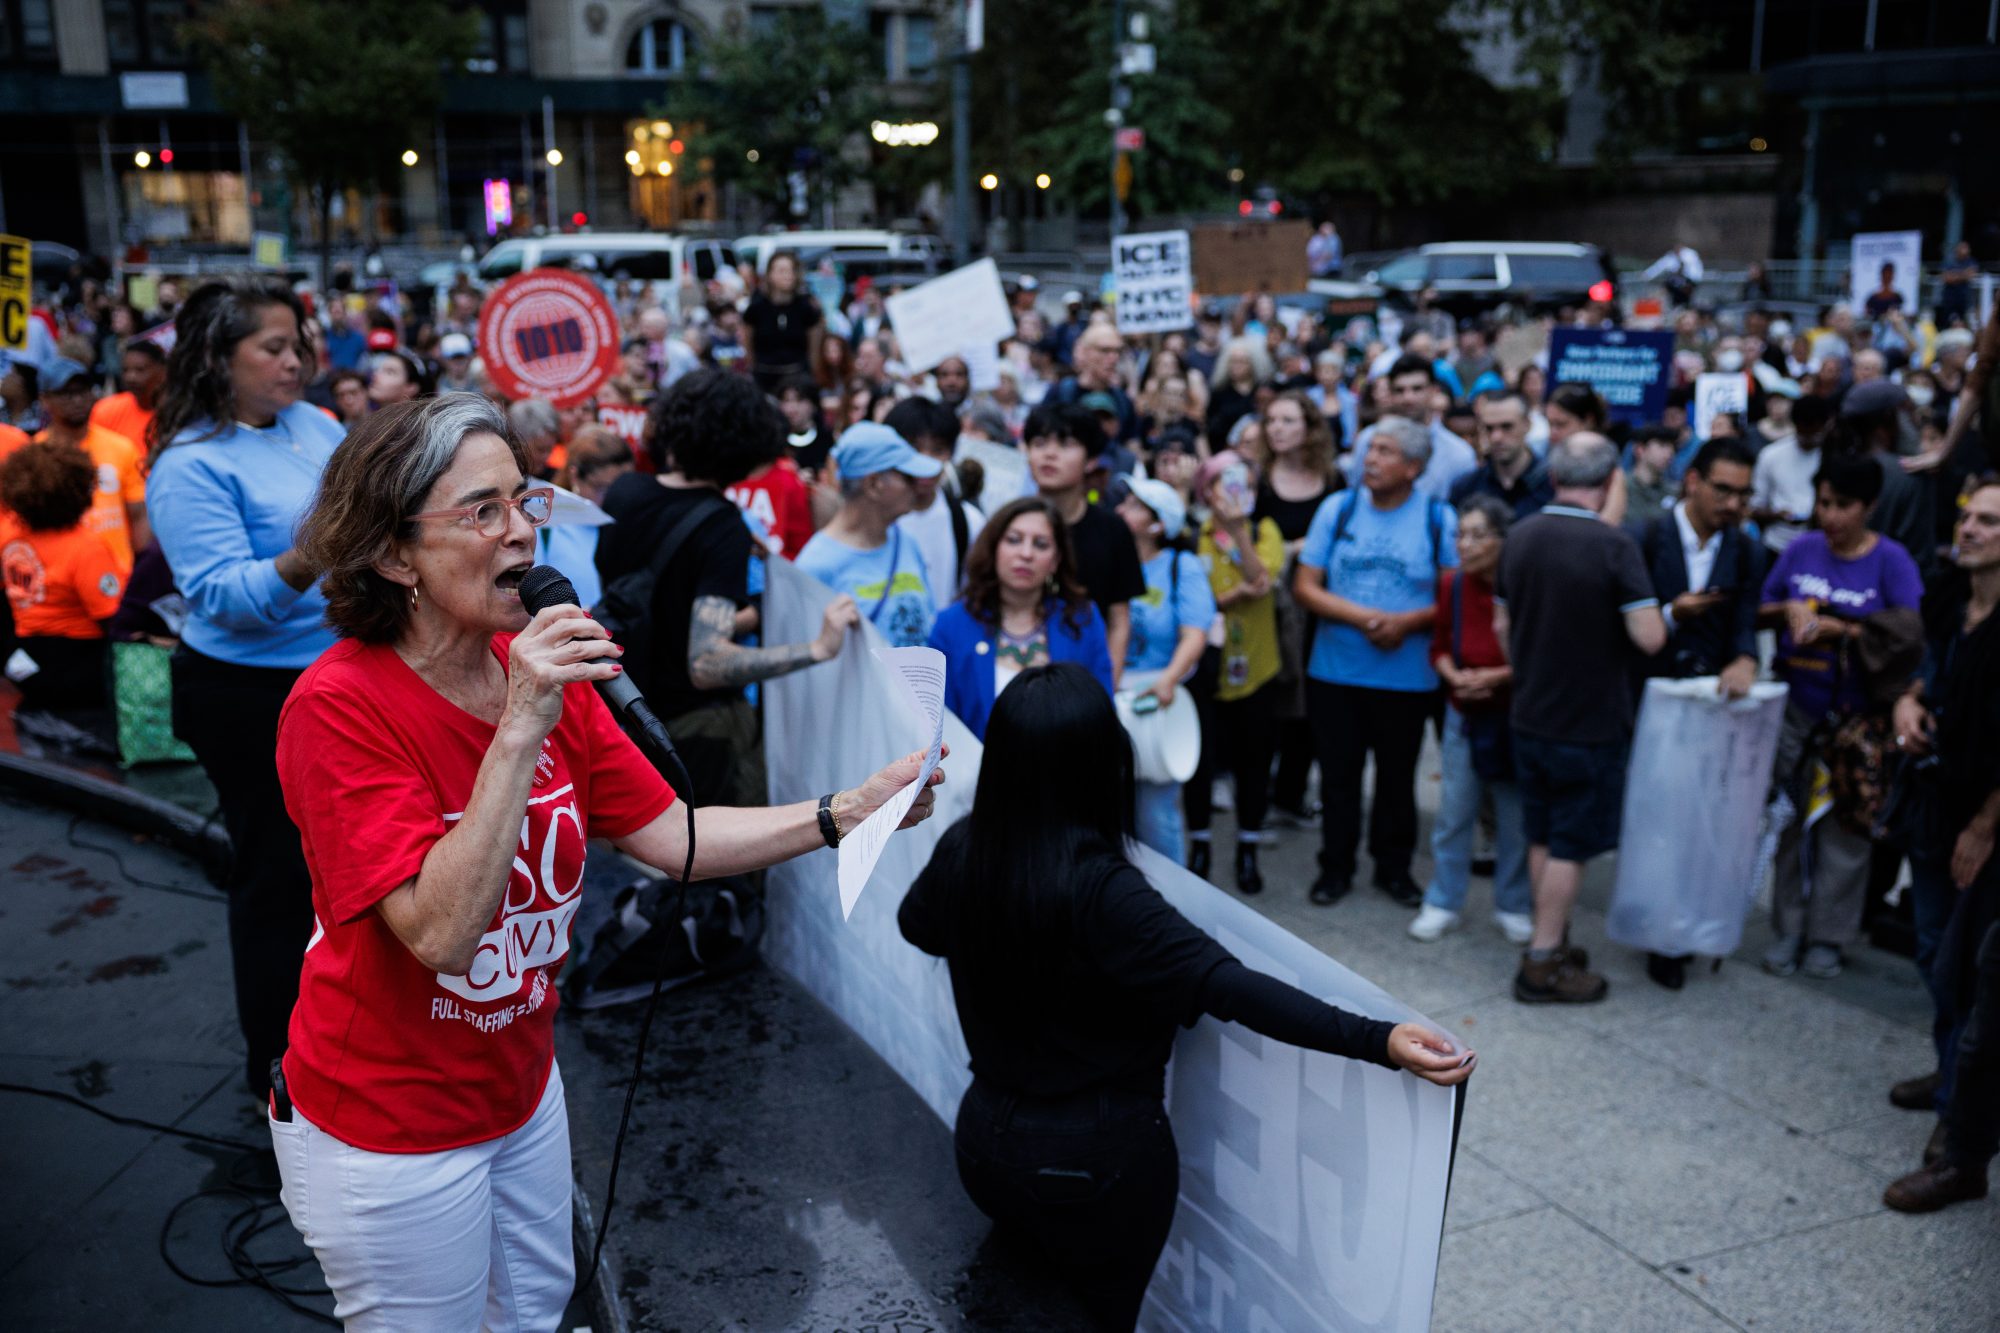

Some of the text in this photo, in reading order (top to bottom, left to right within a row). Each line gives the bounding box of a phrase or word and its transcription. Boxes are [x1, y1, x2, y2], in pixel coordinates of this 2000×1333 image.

[1119, 240, 1182, 265] ICE
[516, 318, 583, 362] 1010
[466, 909, 571, 990] CUNY
[431, 997, 462, 1020] FULL
[463, 1004, 515, 1033] STAFFING
